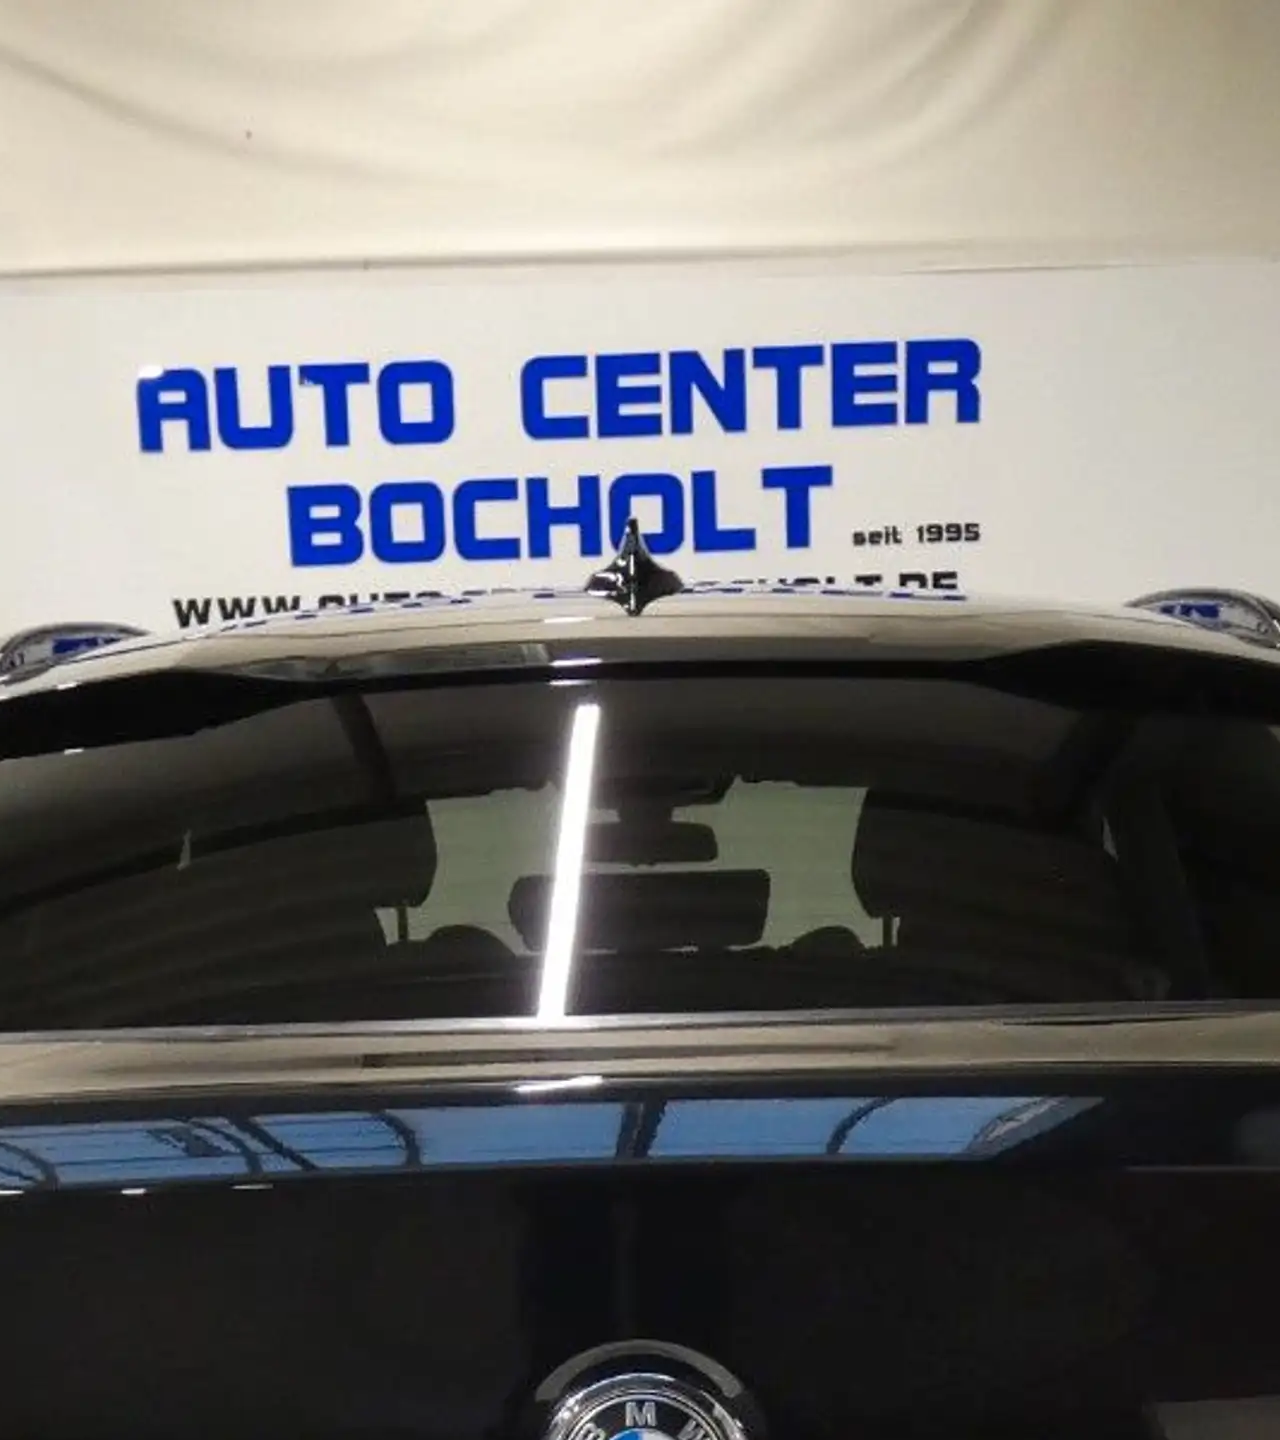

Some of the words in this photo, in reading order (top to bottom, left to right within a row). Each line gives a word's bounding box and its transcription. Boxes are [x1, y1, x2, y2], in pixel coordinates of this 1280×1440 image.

[136, 360, 456, 454] AUTO
[521, 338, 981, 442] CENTER
[286, 465, 834, 567] BOCHOLT
[852, 525, 903, 547] seit
[915, 522, 982, 545] 1995
